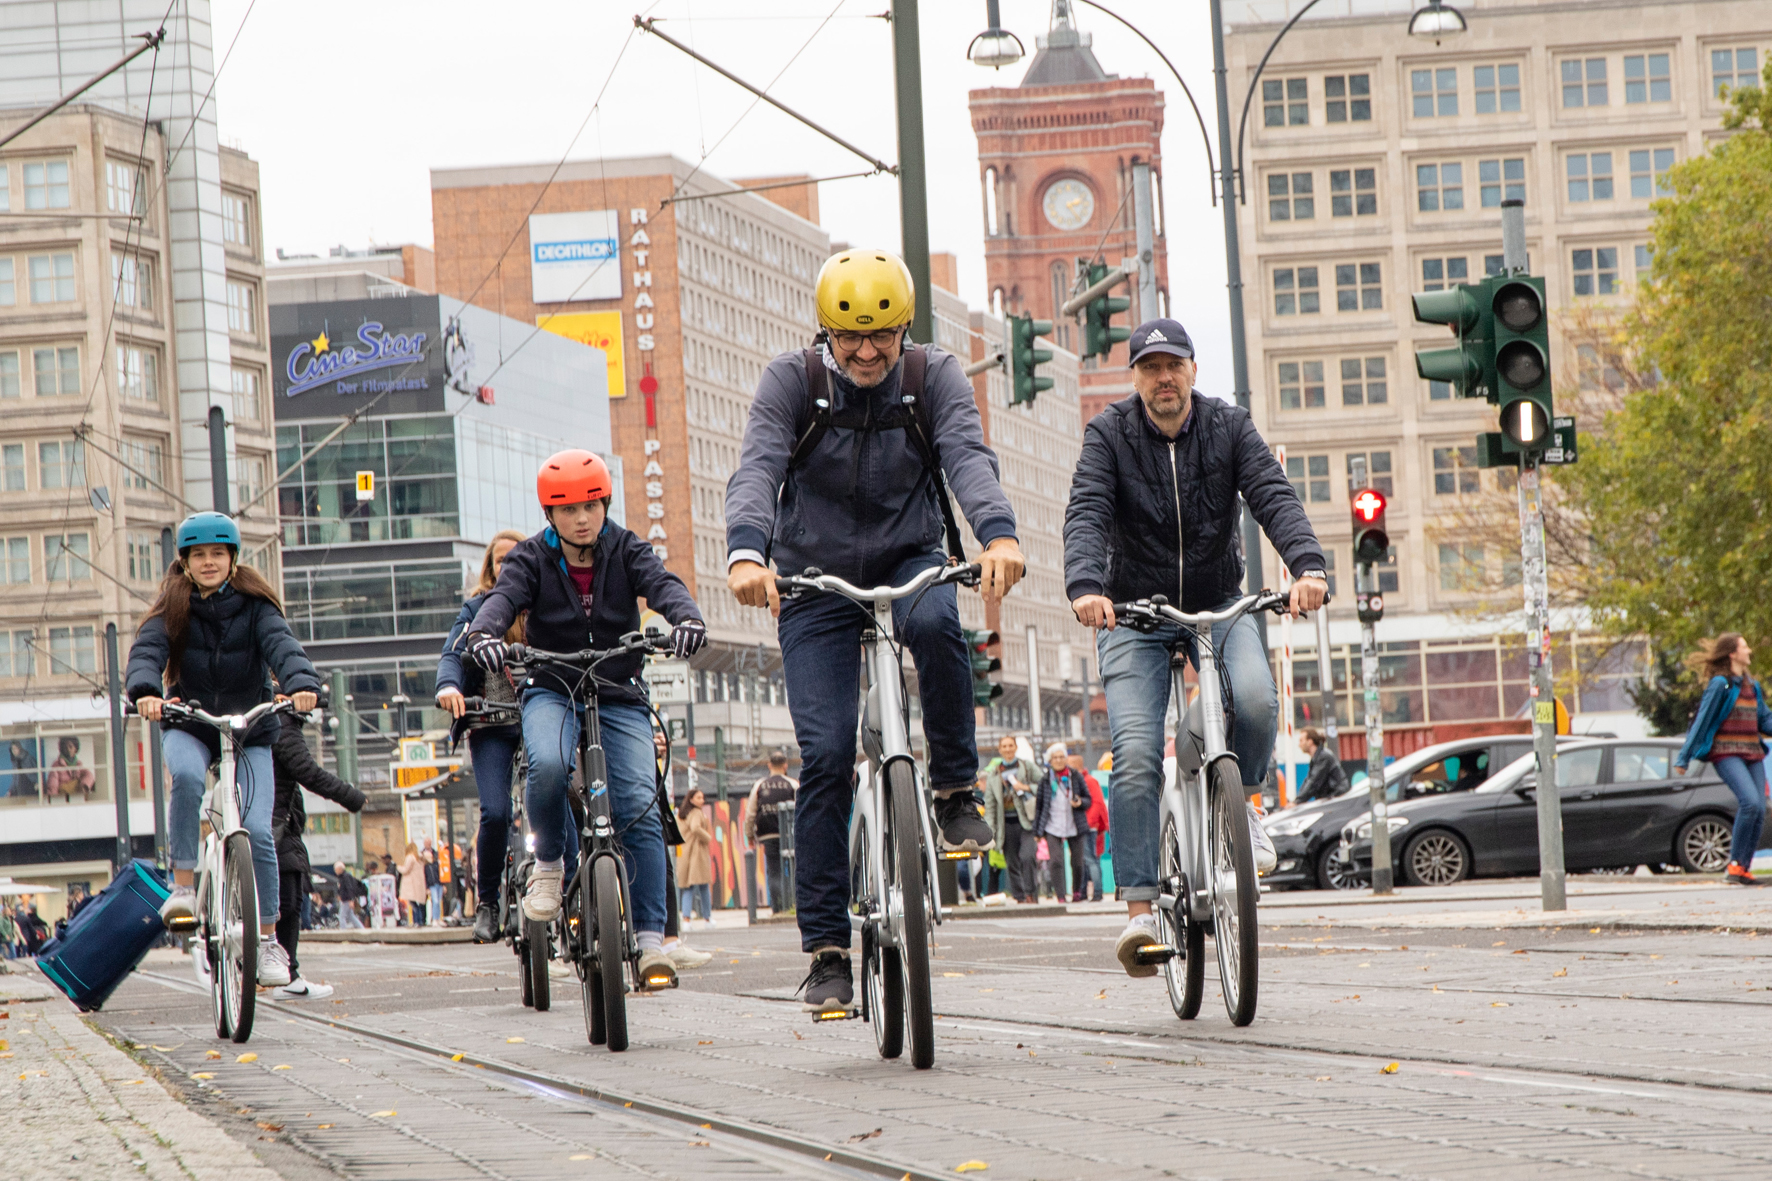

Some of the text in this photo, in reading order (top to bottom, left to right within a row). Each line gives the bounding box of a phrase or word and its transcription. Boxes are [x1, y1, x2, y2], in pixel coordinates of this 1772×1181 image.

[537, 241, 614, 260] DECATHLON
[630, 208, 655, 351] RATHAUS
[287, 321, 427, 384] CineStar
[337, 380, 357, 394] Der
[361, 474, 368, 490] 1
[643, 439, 669, 569] PASSAG
[657, 690, 673, 698] frei
